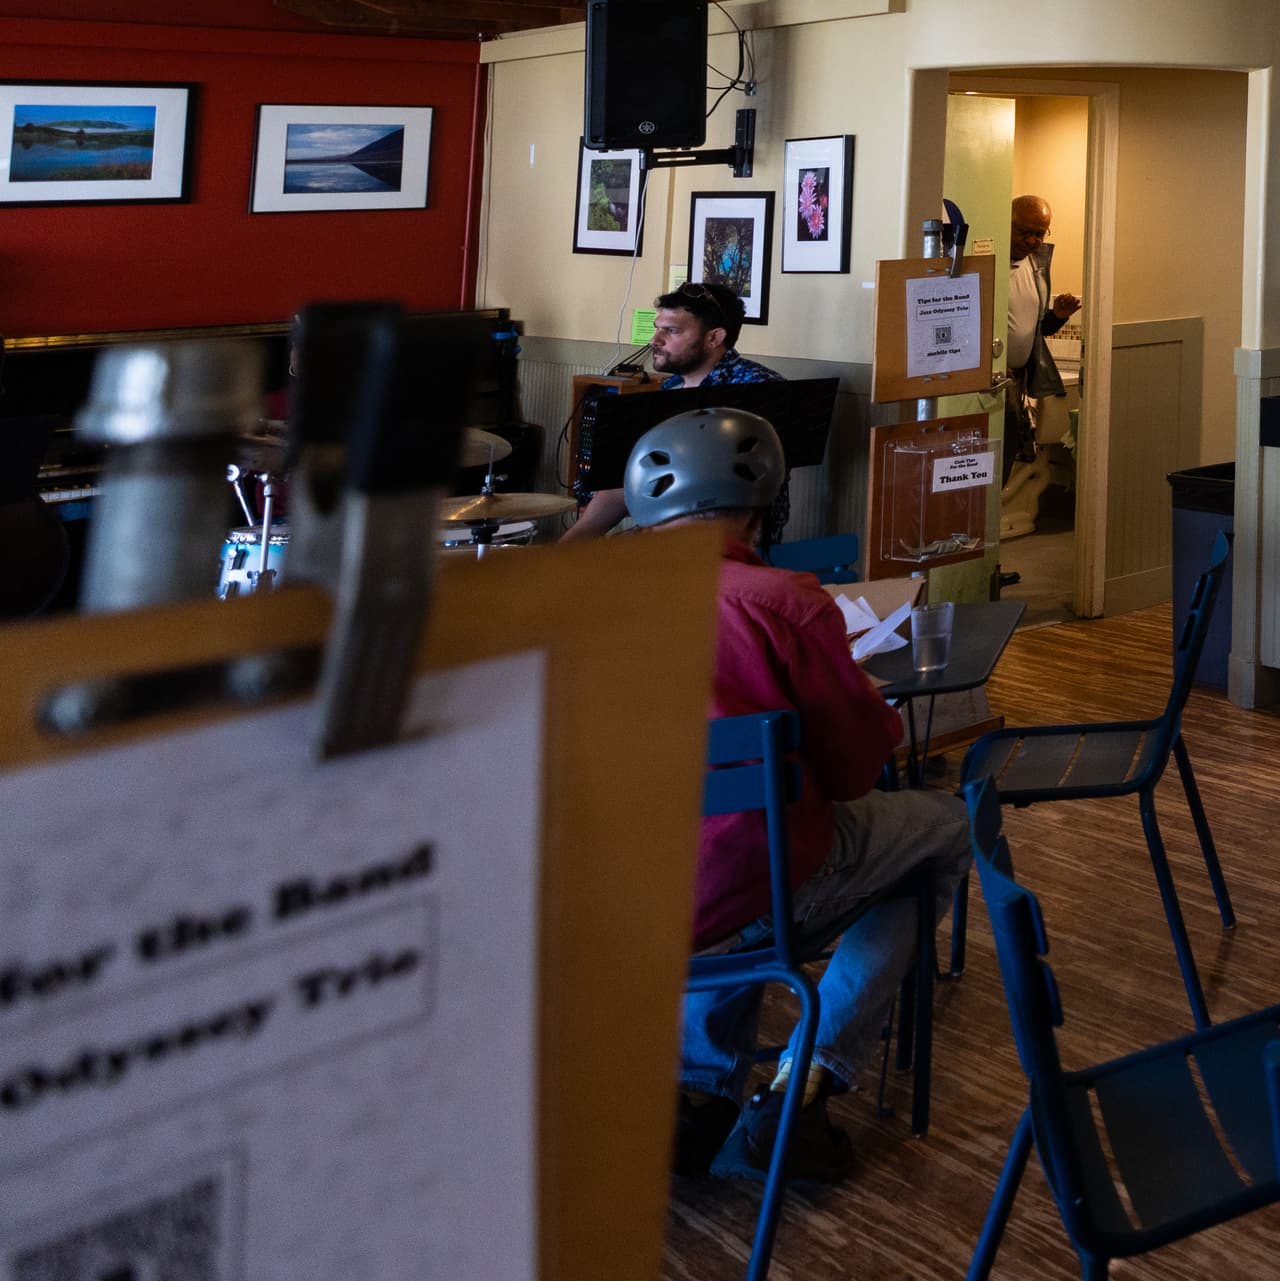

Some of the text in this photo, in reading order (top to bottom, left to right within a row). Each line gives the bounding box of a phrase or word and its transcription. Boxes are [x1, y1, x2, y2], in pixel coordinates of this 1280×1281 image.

[954, 293, 970, 301] Band
[939, 471, 988, 484] Thank You
[135, 903, 258, 964] the
[271, 840, 436, 921] Band
[294, 948, 420, 1010] Trio
